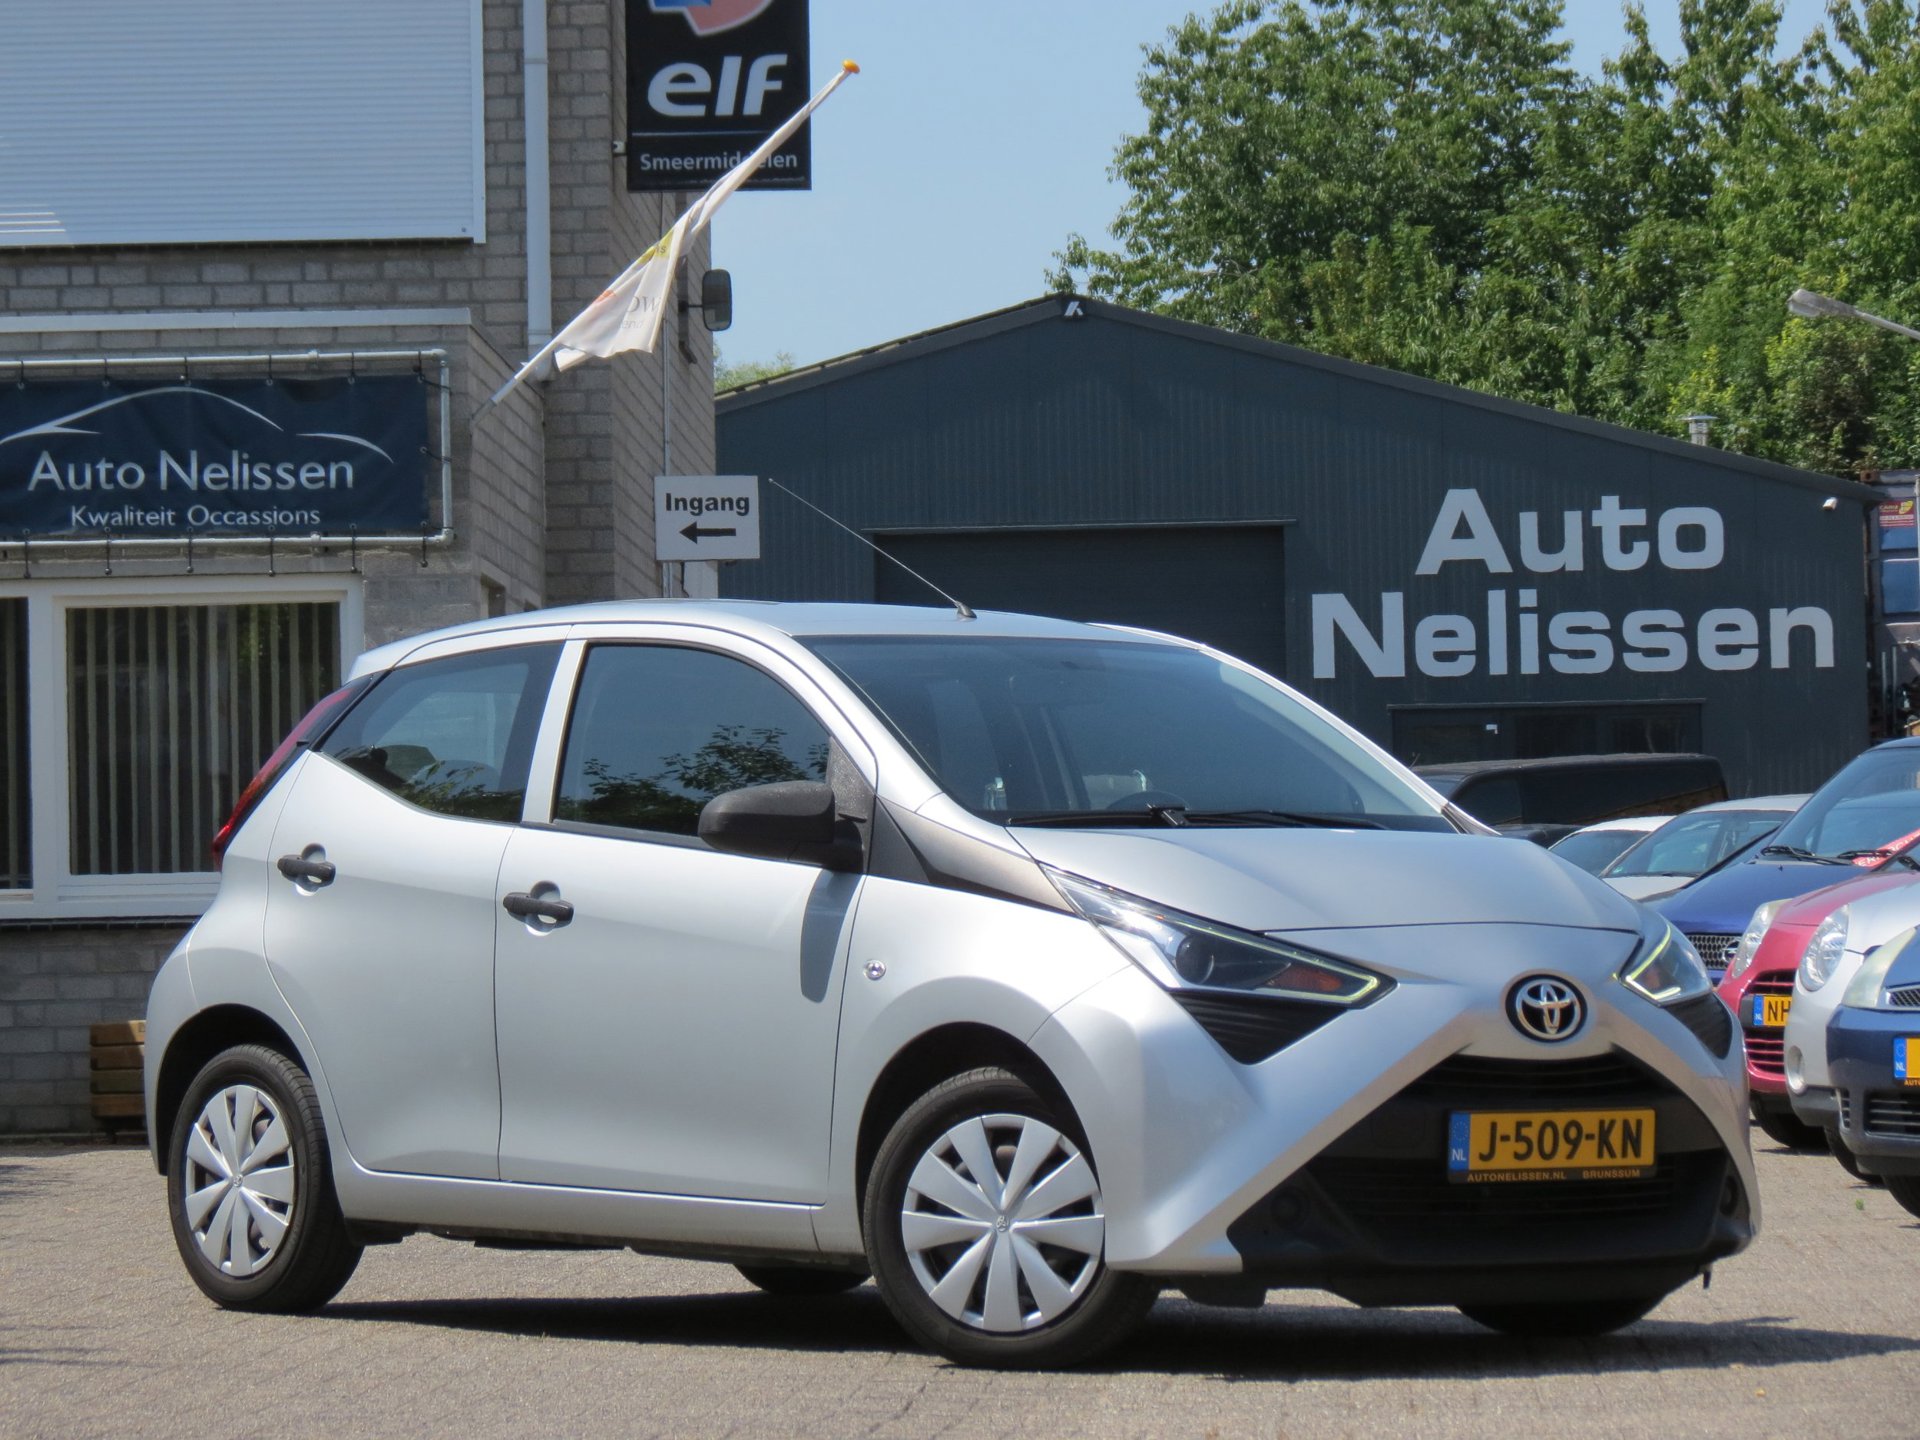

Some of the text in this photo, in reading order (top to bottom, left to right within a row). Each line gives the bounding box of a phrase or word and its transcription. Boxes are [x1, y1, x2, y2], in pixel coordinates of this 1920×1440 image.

[647, 54, 788, 118] elf
[639, 151, 798, 171] Smeermidlen
[27, 449, 355, 491] Auto Nelissen
[71, 504, 321, 527] Kwaliteit Occassions
[665, 492, 750, 517] Ingang
[1414, 487, 1725, 576] Auto
[1311, 588, 1835, 679] Nelissen
[1451, 1148, 1467, 1162] NL
[1478, 1118, 1643, 1162] J-509-KN
[1467, 1168, 1641, 1182] AUTONELISSEN.NL BRUNSSUM
